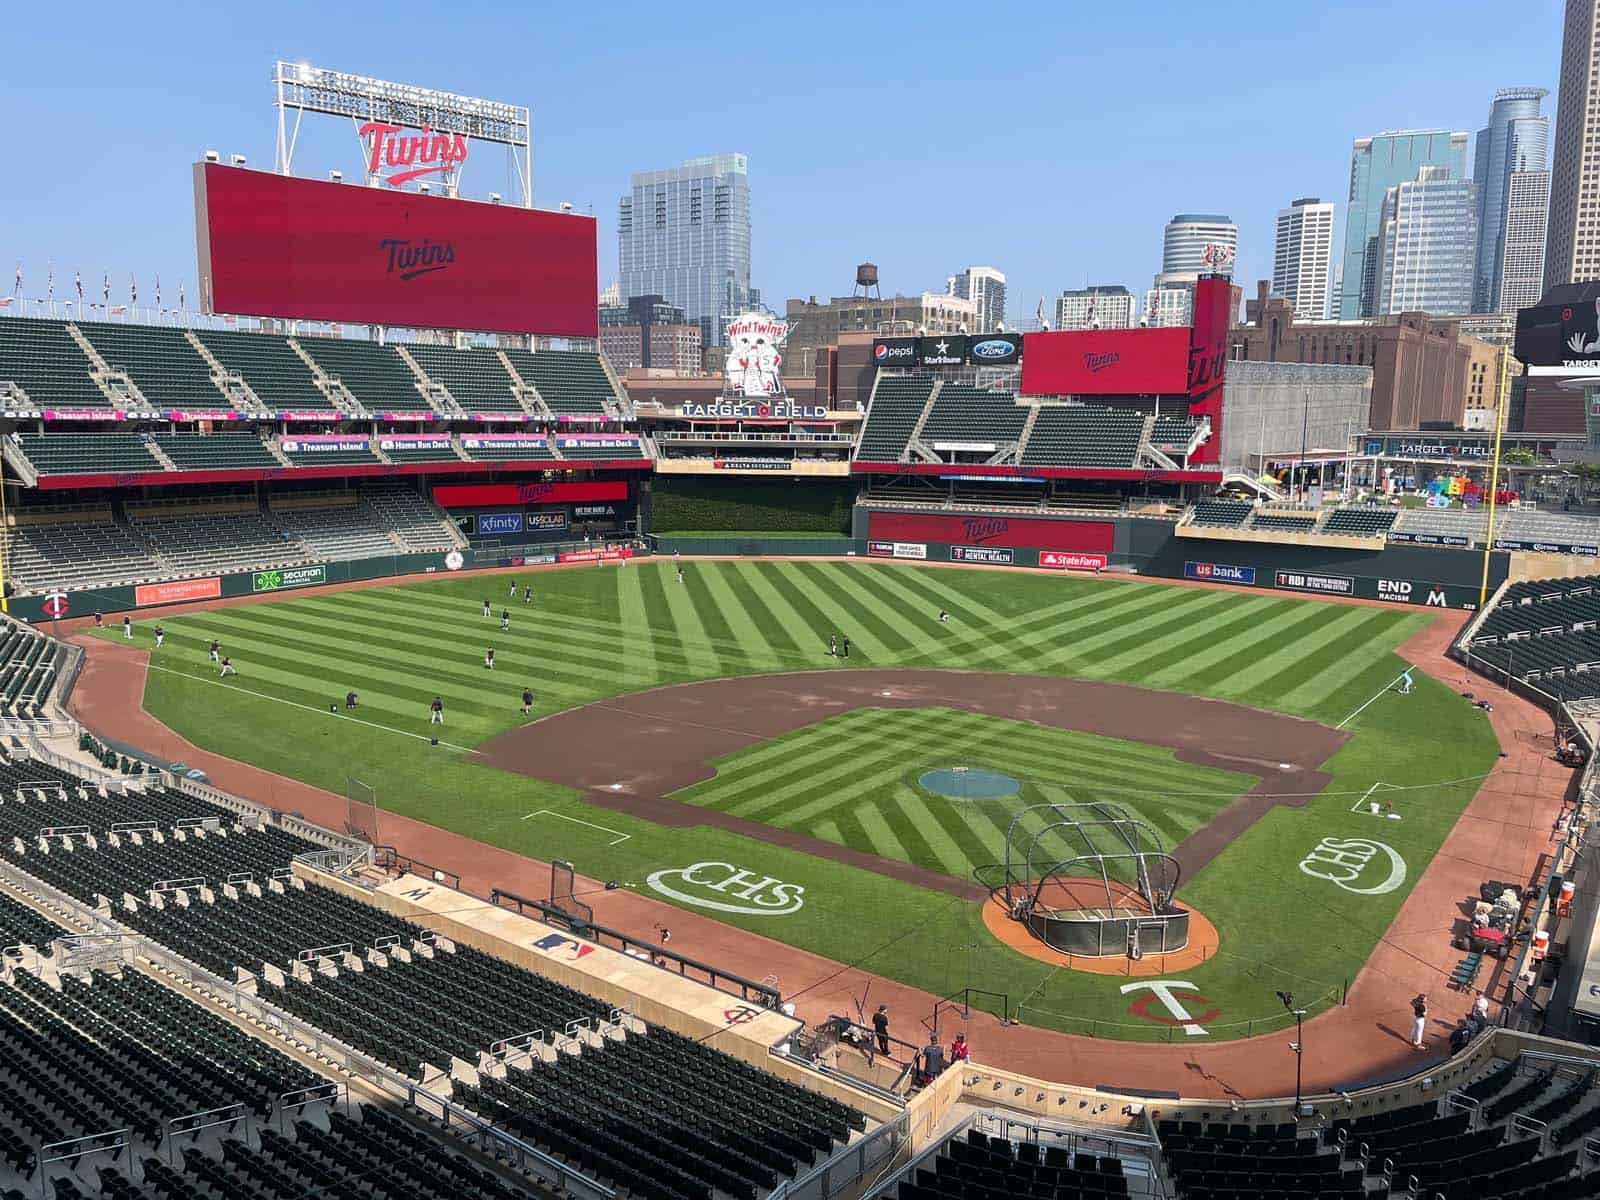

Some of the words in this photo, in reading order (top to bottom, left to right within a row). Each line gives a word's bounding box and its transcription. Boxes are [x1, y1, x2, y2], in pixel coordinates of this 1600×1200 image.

[359, 122, 467, 184] Twins
[379, 239, 455, 280] Twins
[727, 321, 752, 336] Win!
[753, 320, 788, 336] Twins!
[888, 344, 914, 357] pepsi
[980, 343, 1006, 355] Ford
[1083, 351, 1121, 373] Twins
[682, 404, 757, 417] TARGET
[774, 404, 828, 418] FIELD
[302, 442, 338, 451] Treasure
[340, 441, 364, 451] Island
[434, 440, 450, 449] Deck
[1399, 444, 1446, 455] TARGET
[483, 514, 520, 531] xfinity
[961, 518, 1008, 543] Twins
[283, 568, 322, 580] securian
[1197, 563, 1211, 576] us
[1213, 563, 1243, 579] bank
[1377, 580, 1412, 593] END
[1378, 593, 1409, 602] RACISM
[681, 862, 805, 907] CHS
